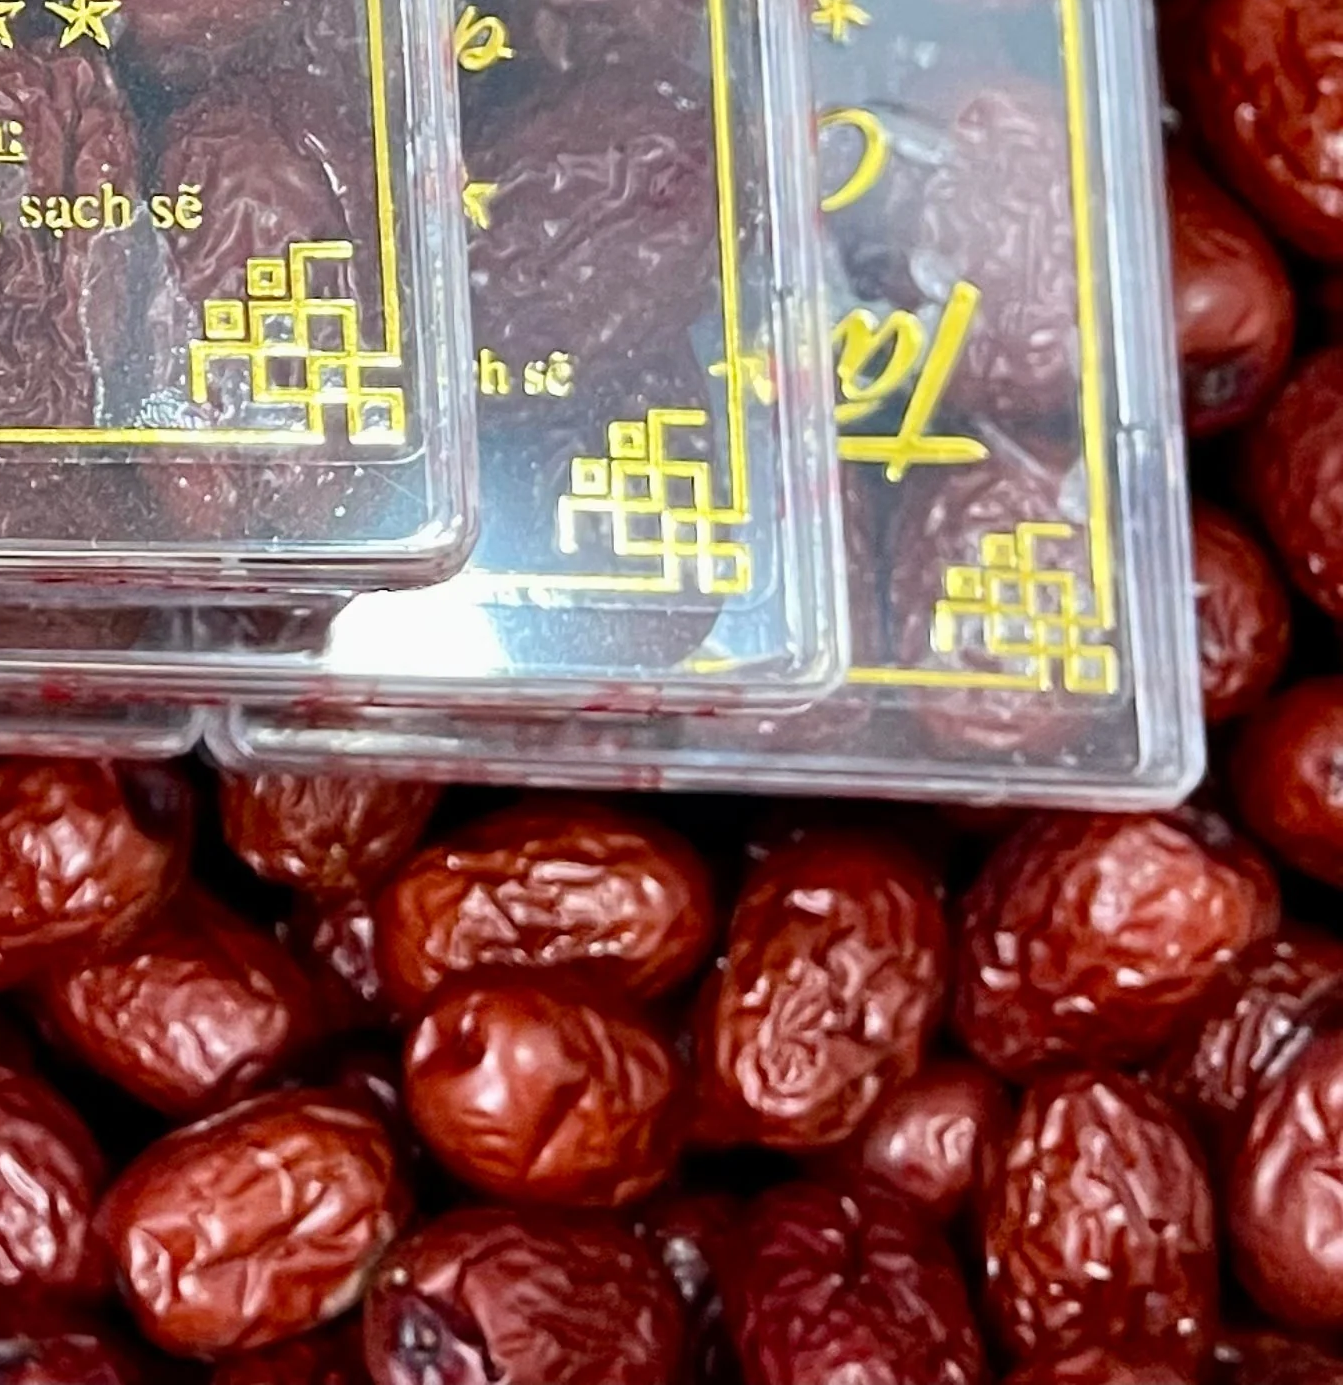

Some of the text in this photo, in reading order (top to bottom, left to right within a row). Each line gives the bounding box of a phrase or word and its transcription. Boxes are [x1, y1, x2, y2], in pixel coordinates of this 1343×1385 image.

[19, 182, 132, 238] sạch
[152, 183, 204, 230] sẽ
[523, 349, 576, 397] sẽ
[833, 282, 989, 482] Tá
